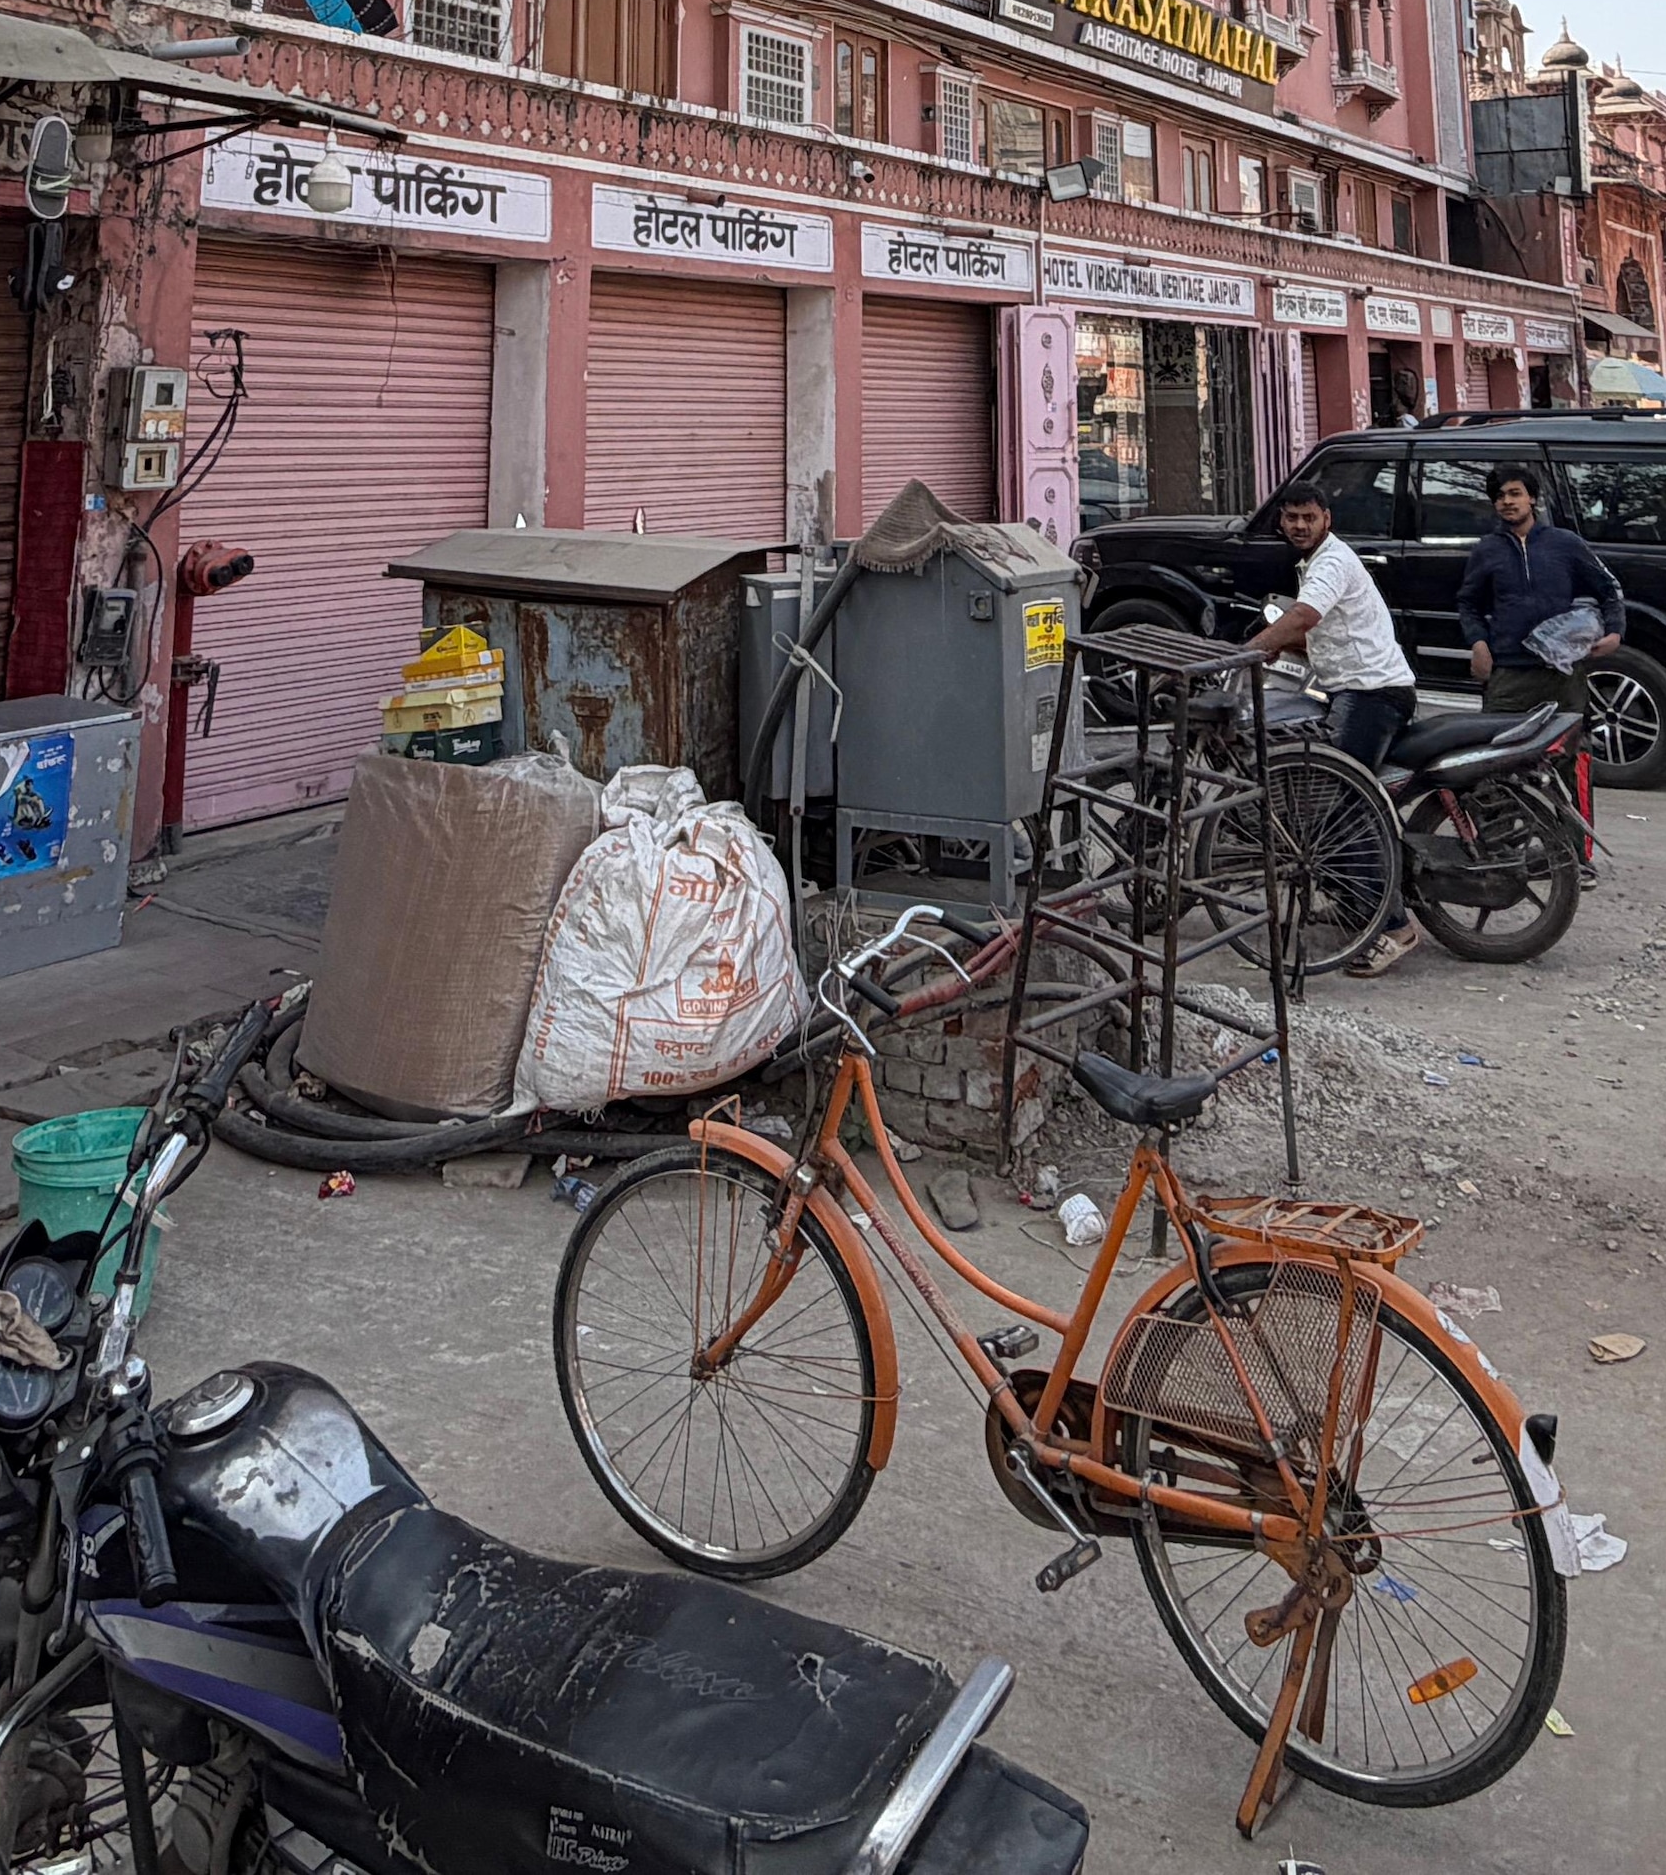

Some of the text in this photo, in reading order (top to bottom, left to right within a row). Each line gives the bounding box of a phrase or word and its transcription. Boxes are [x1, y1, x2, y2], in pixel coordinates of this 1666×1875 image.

[1095, 26, 1159, 67] HERITAGE
[365, 164, 507, 223] पार्किंग
[633, 196, 799, 257] होटल पार्किंग
[887, 231, 1006, 281] होटल पार्किंग
[1042, 256, 1083, 289] HOTEL
[1161, 272, 1206, 303] HERITAGE
[1207, 279, 1241, 307] JAIPUR
